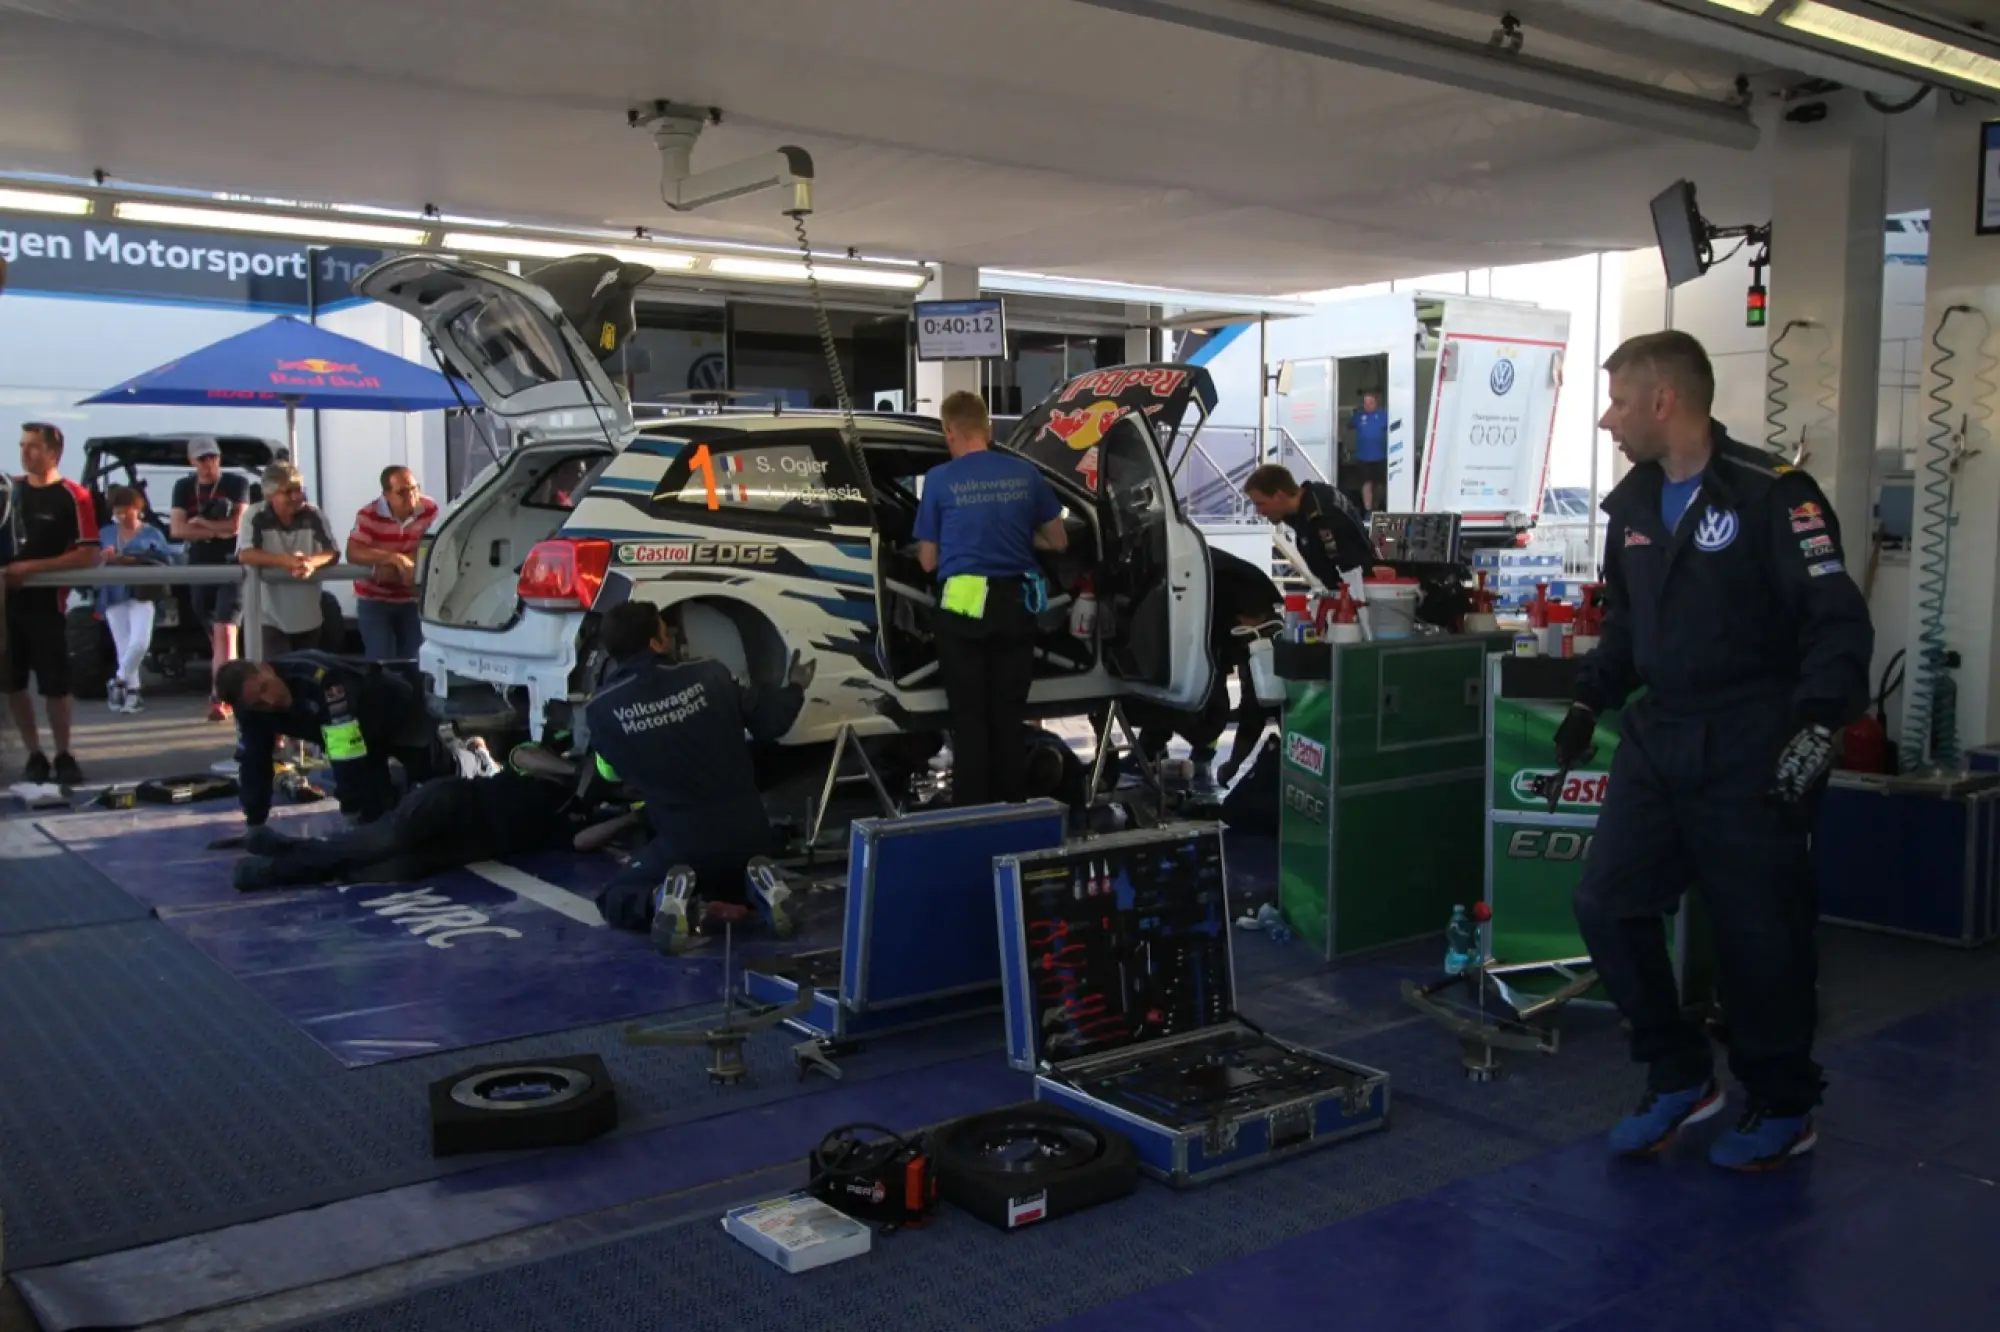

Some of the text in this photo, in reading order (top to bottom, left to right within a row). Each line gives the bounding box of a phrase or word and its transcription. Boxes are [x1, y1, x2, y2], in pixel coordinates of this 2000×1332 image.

[84, 230, 307, 281] Motorsport
[924, 316, 995, 335] 0:40:12
[269, 371, 381, 389] Red Bull
[688, 444, 720, 511] 1
[756, 456, 829, 475] S. Ogier
[634, 544, 779, 564] Castrol EDGE
[613, 683, 705, 722] Volkswagen
[621, 696, 709, 735] Motorsport
[358, 886, 524, 949] WRC
